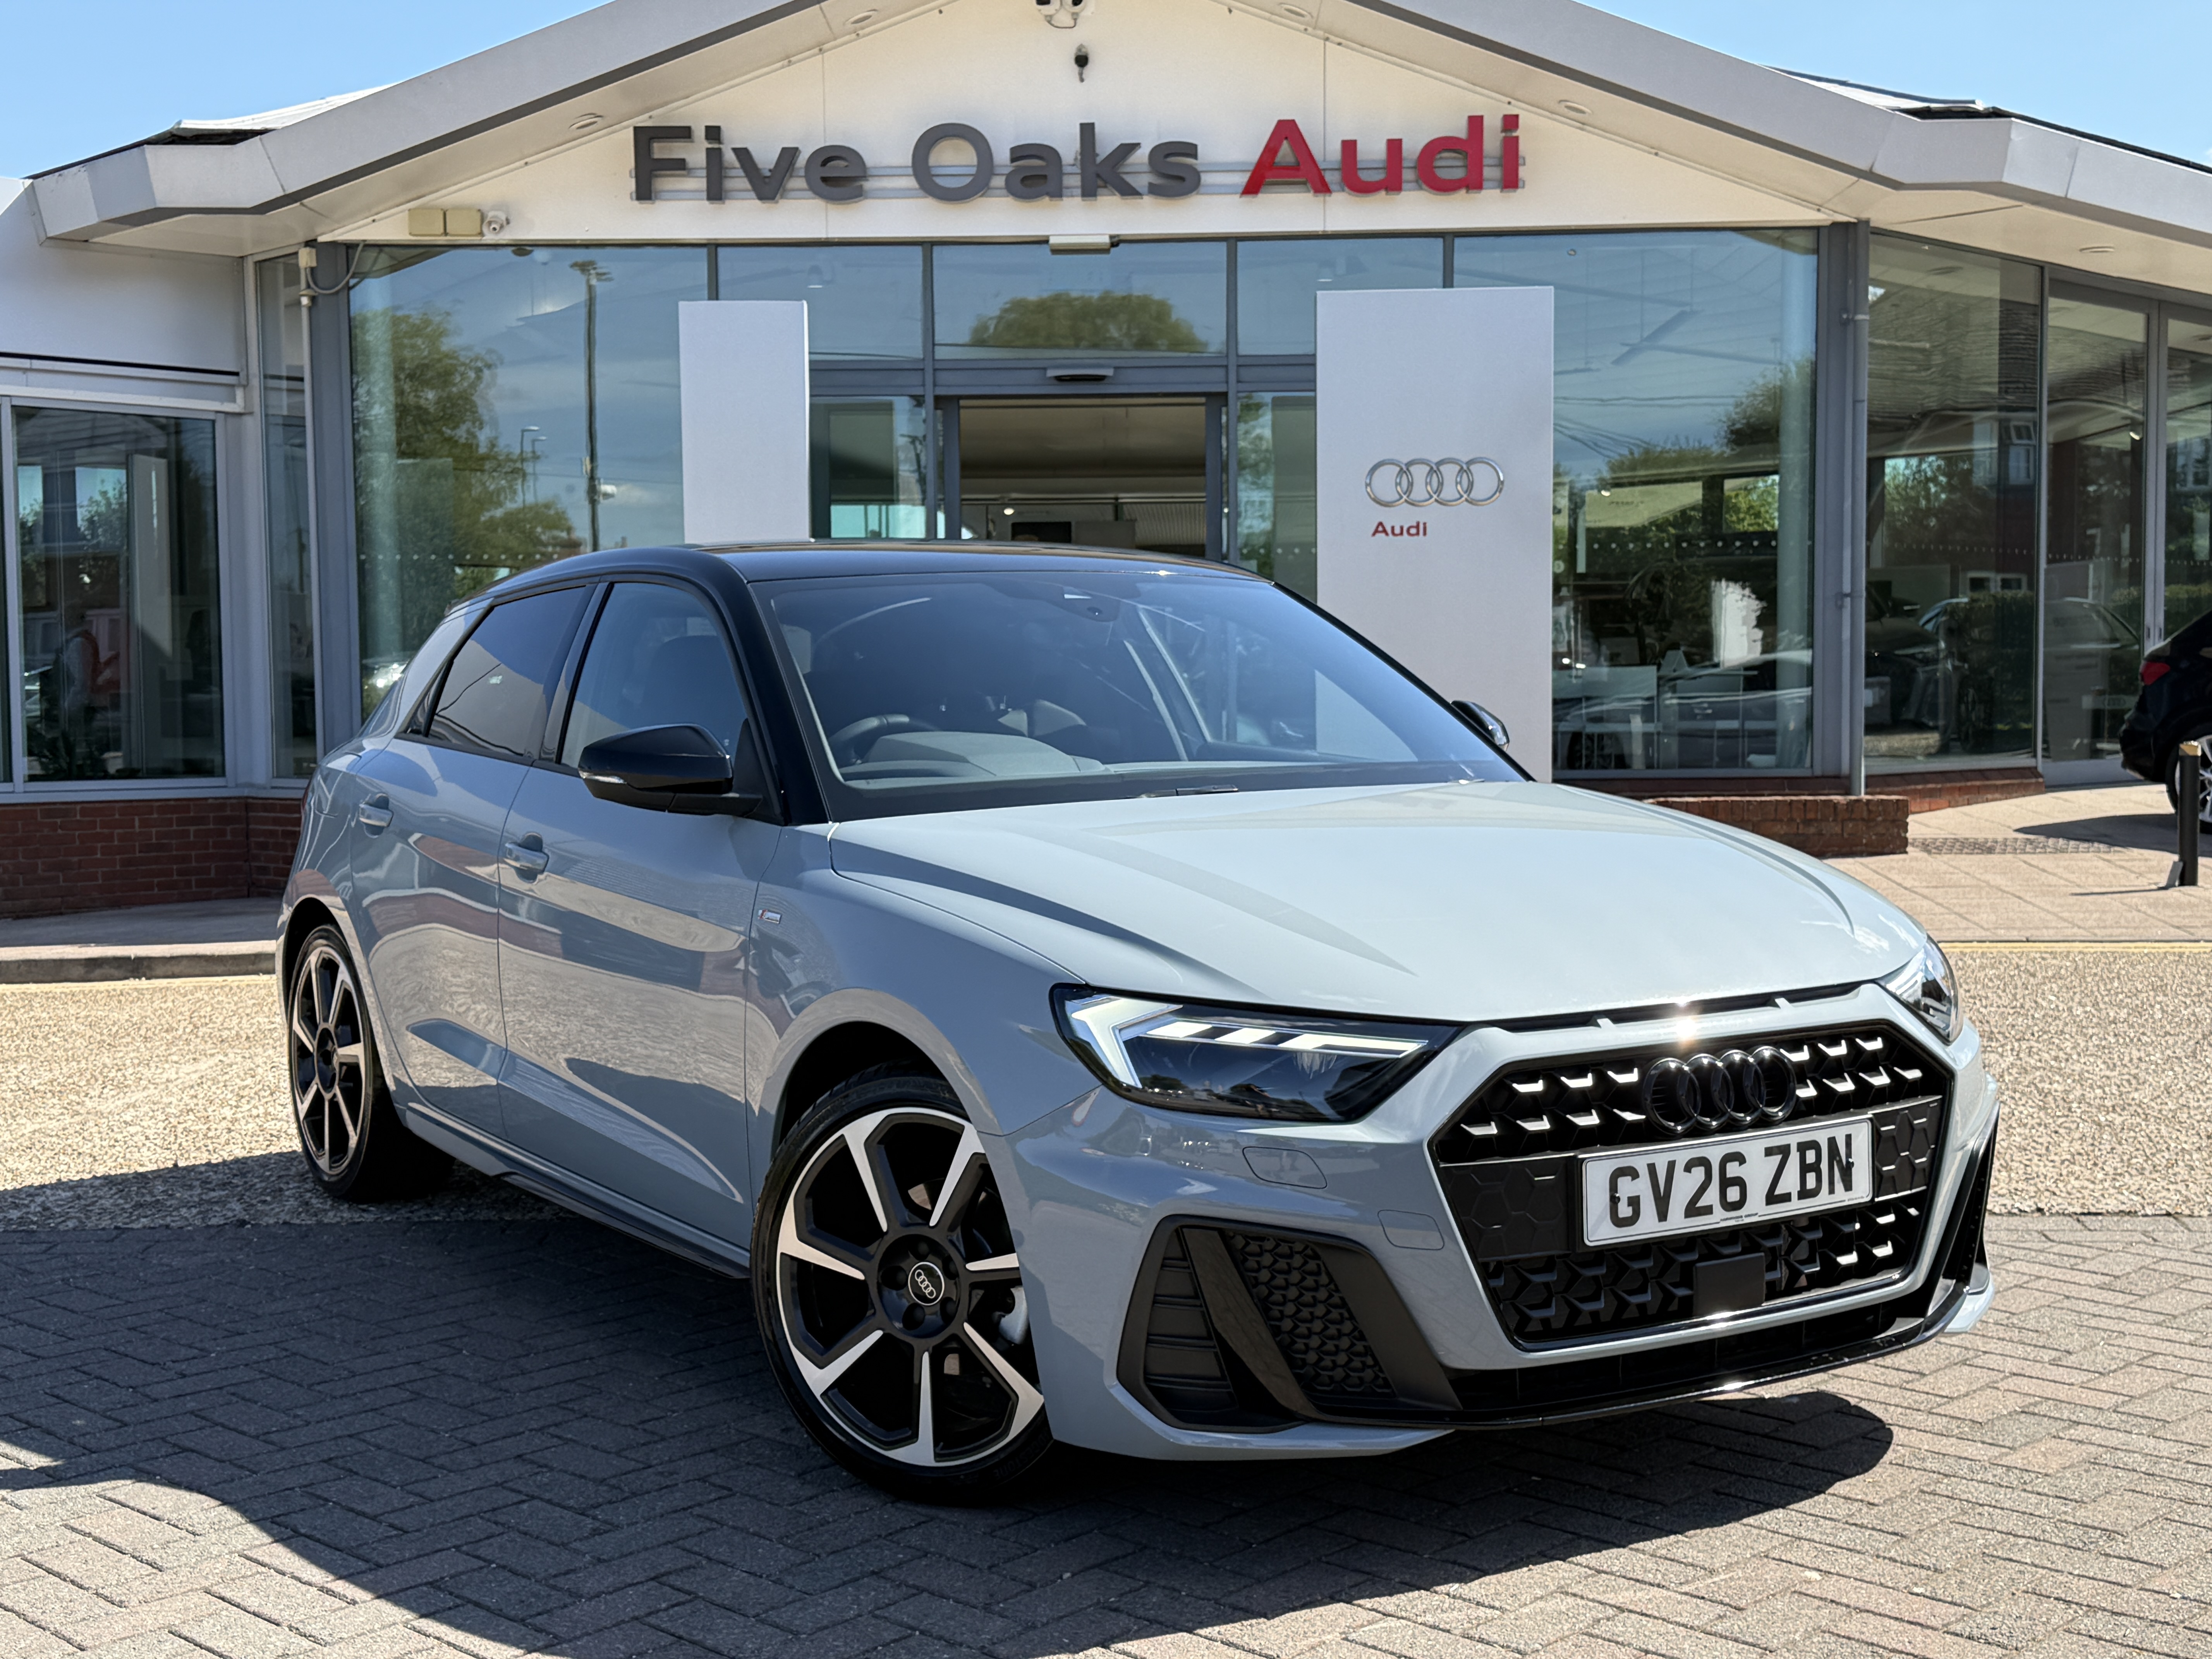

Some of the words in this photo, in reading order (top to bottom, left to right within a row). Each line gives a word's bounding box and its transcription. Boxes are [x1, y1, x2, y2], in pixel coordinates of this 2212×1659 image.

[634, 125, 867, 204] Five
[912, 122, 1201, 203] Oaks
[1240, 114, 1519, 197] Audi
[1371, 520, 1427, 537] Audi
[1609, 1151, 1747, 1228] GV26
[1764, 1133, 1853, 1206] ZBN
